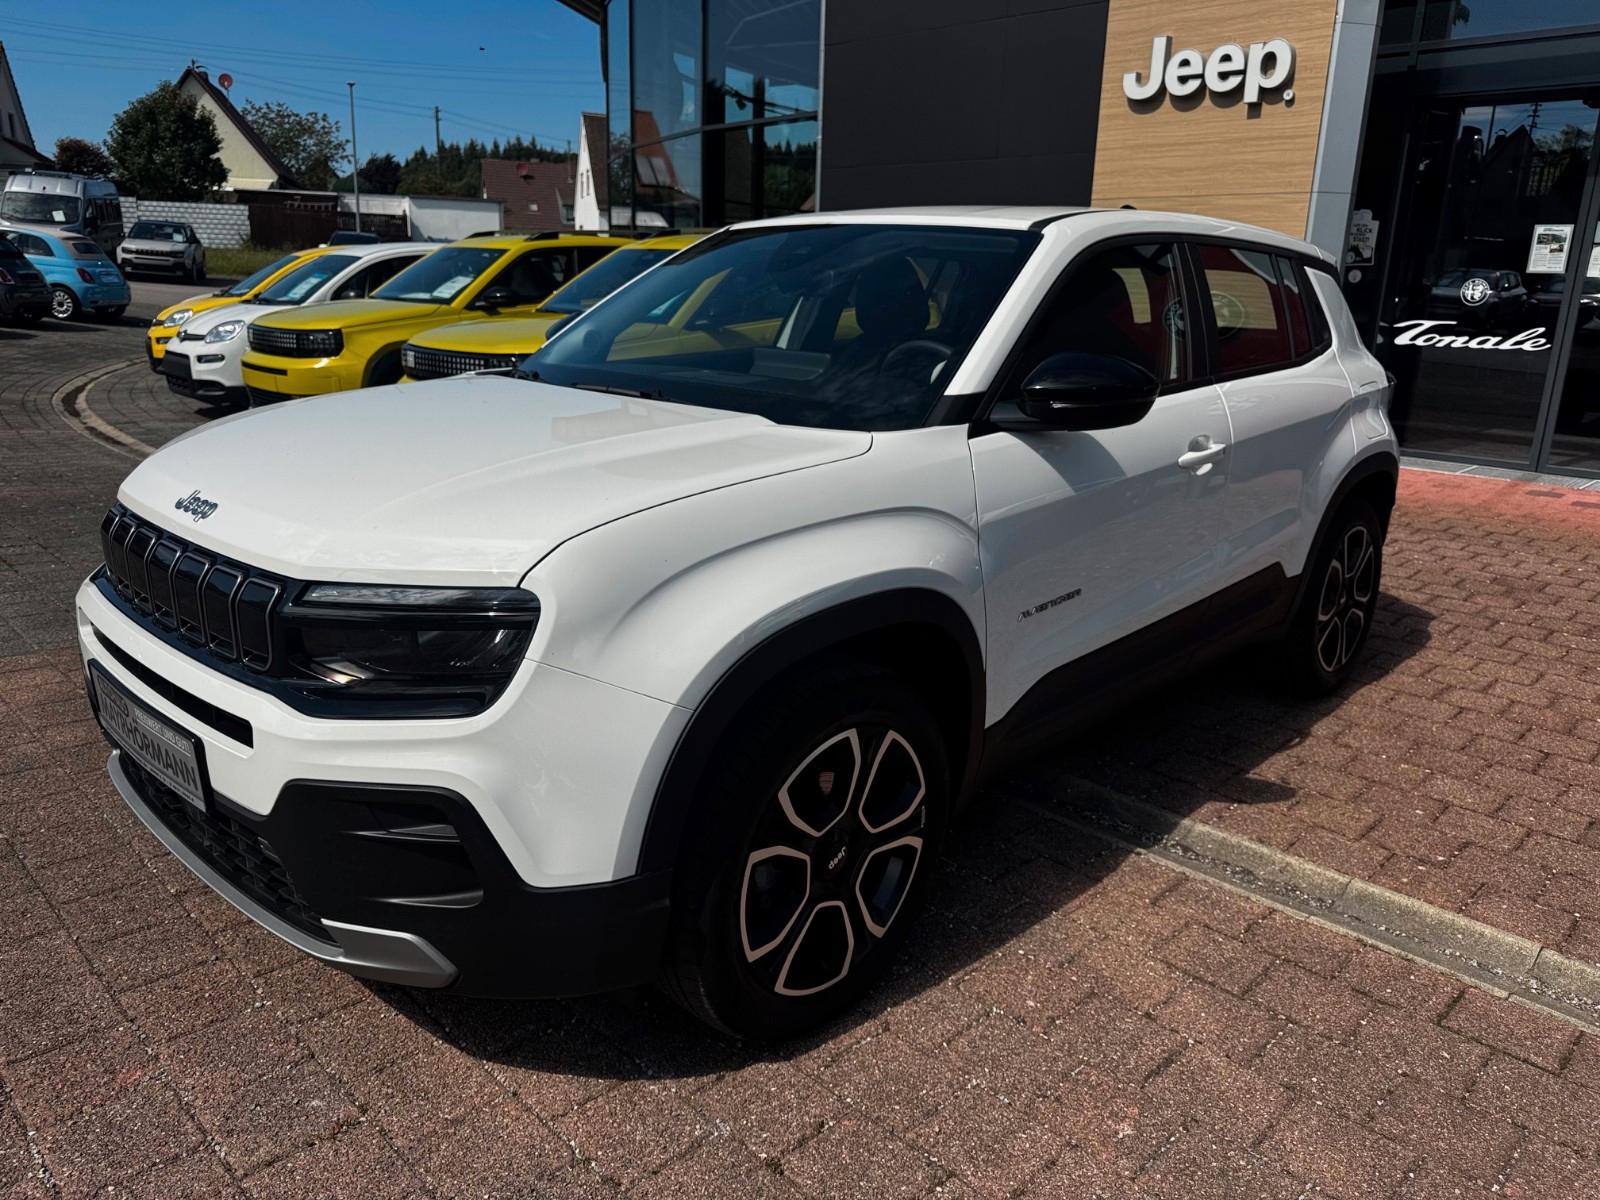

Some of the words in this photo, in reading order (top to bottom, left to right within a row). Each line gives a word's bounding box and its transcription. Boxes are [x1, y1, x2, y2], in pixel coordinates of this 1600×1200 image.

[1122, 35, 1294, 104] Jeep
[1393, 319, 1551, 352] Tonale
[174, 489, 219, 523] Jeep
